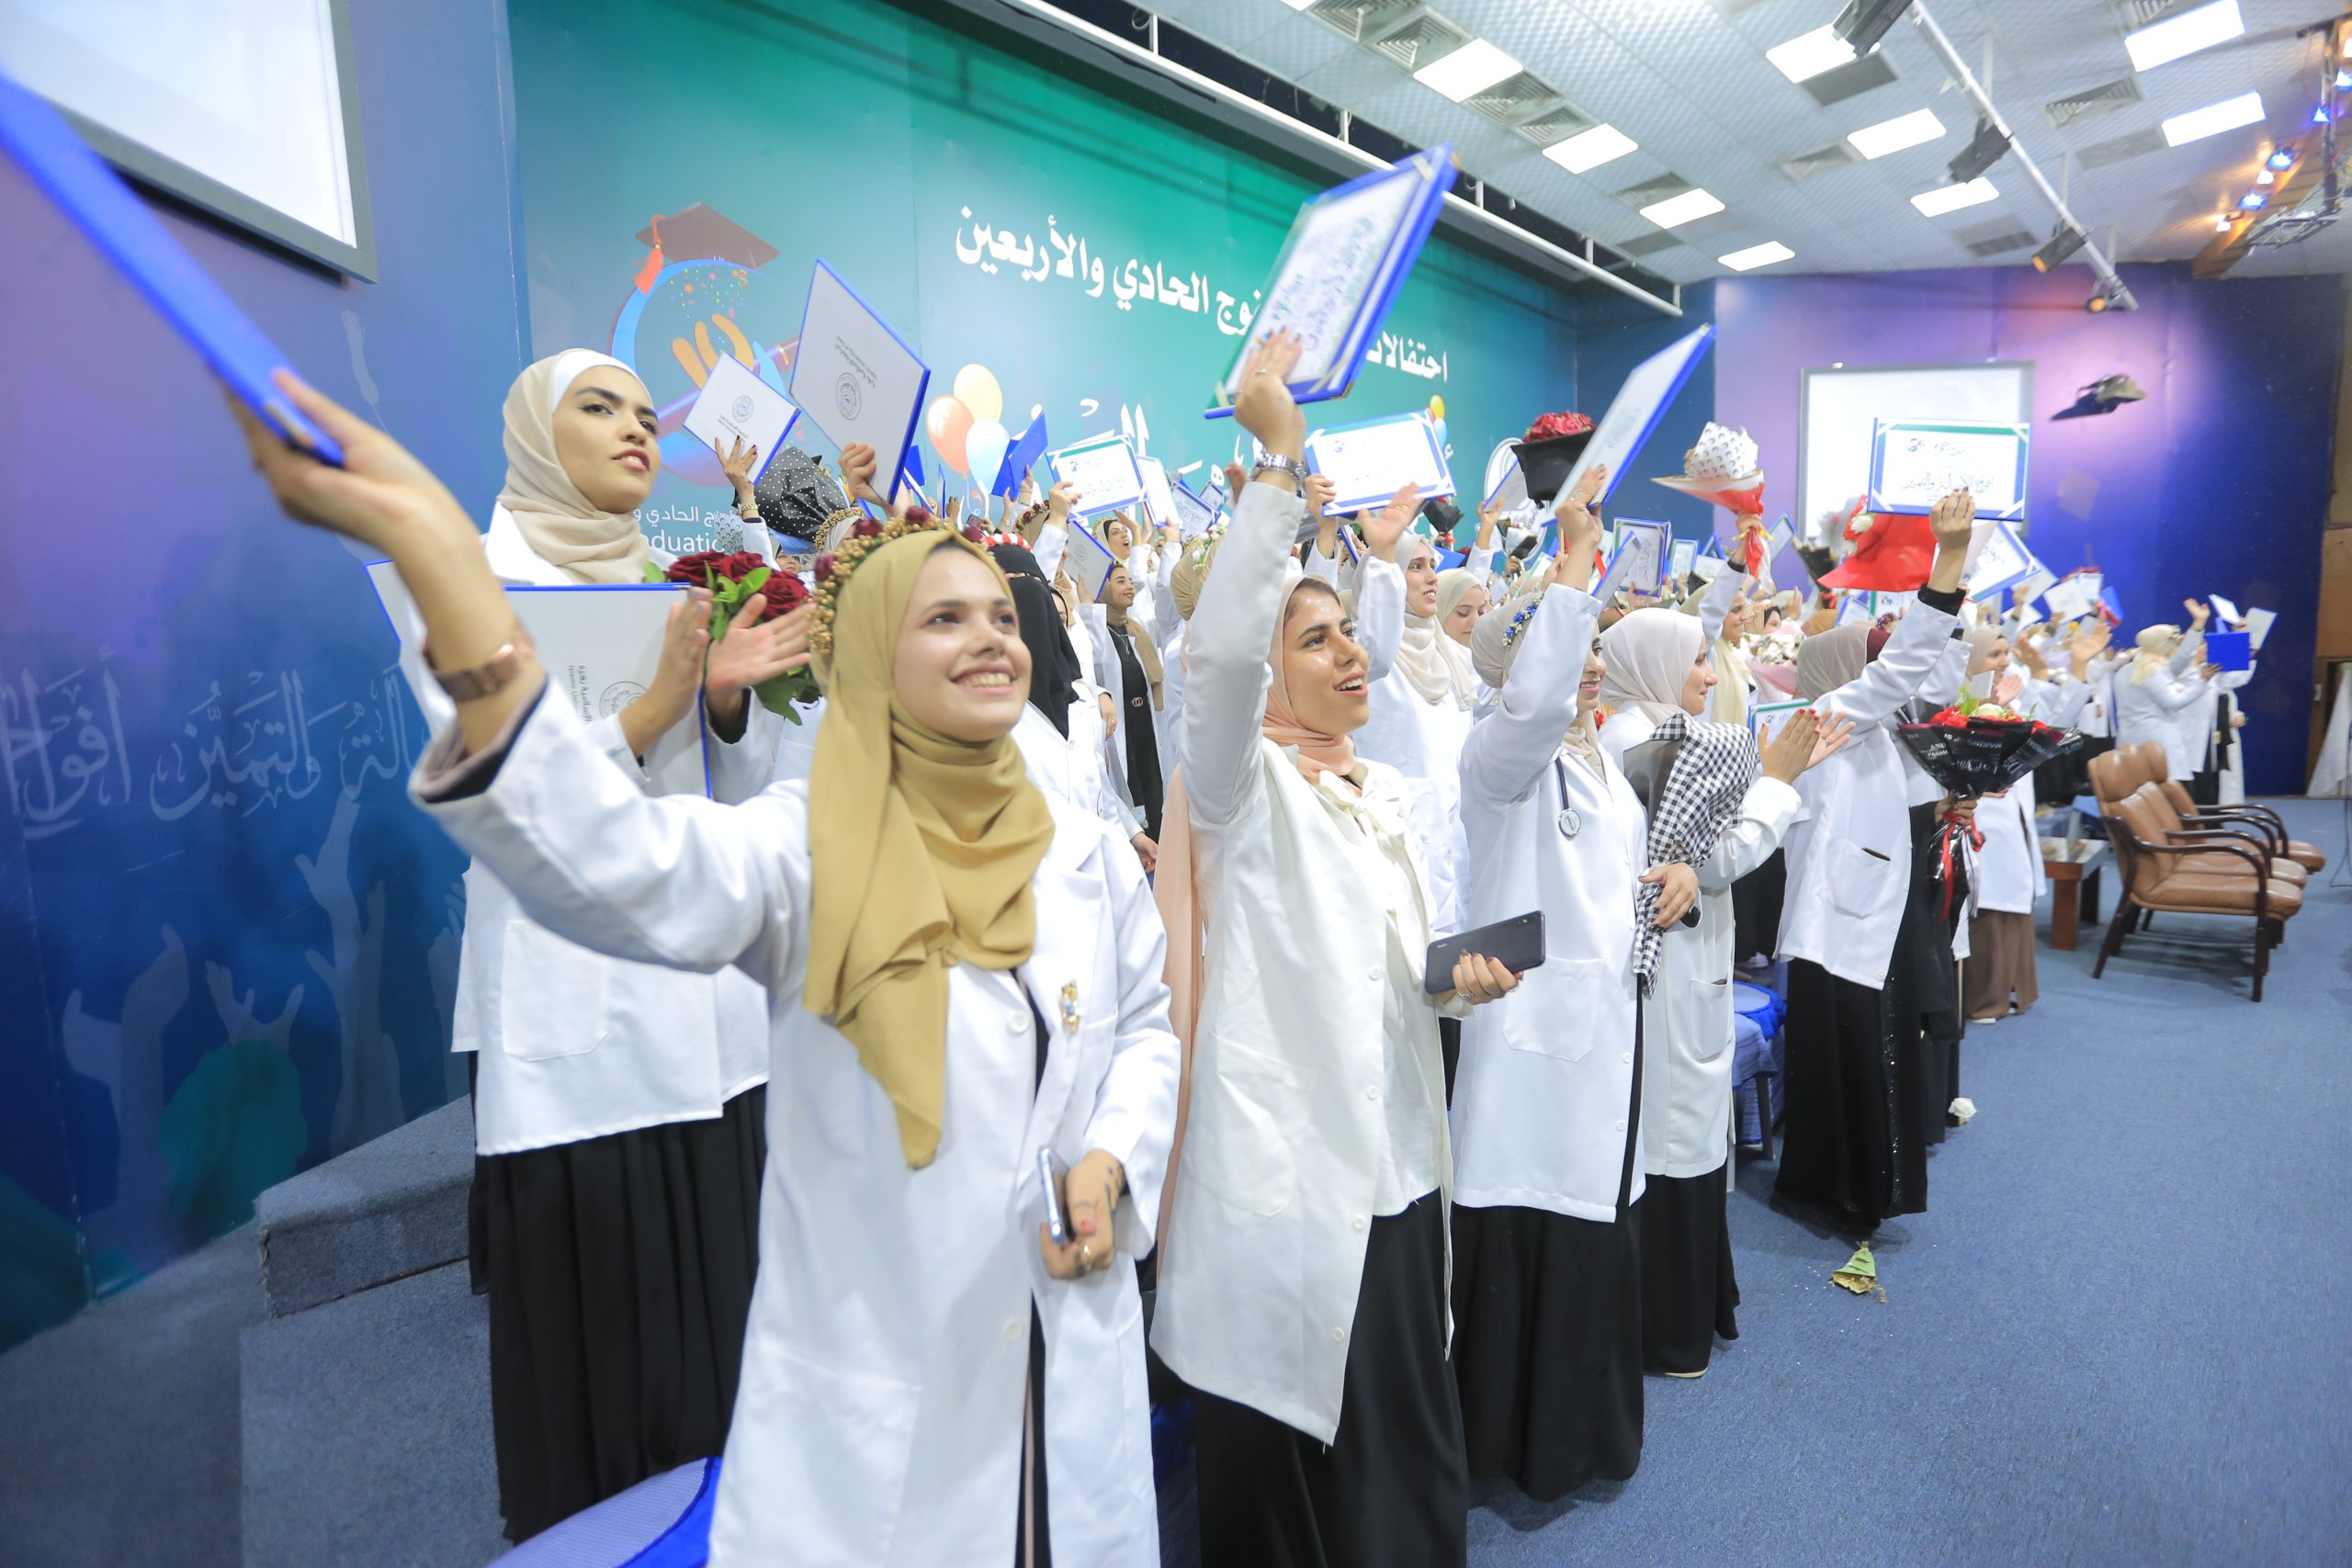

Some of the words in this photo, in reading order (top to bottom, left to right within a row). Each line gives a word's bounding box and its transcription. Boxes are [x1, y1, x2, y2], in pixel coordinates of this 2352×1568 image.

[956, 205, 1104, 298] والأربعين
[1113, 258, 1208, 314] الحادي
[646, 504, 699, 527] الحادي
